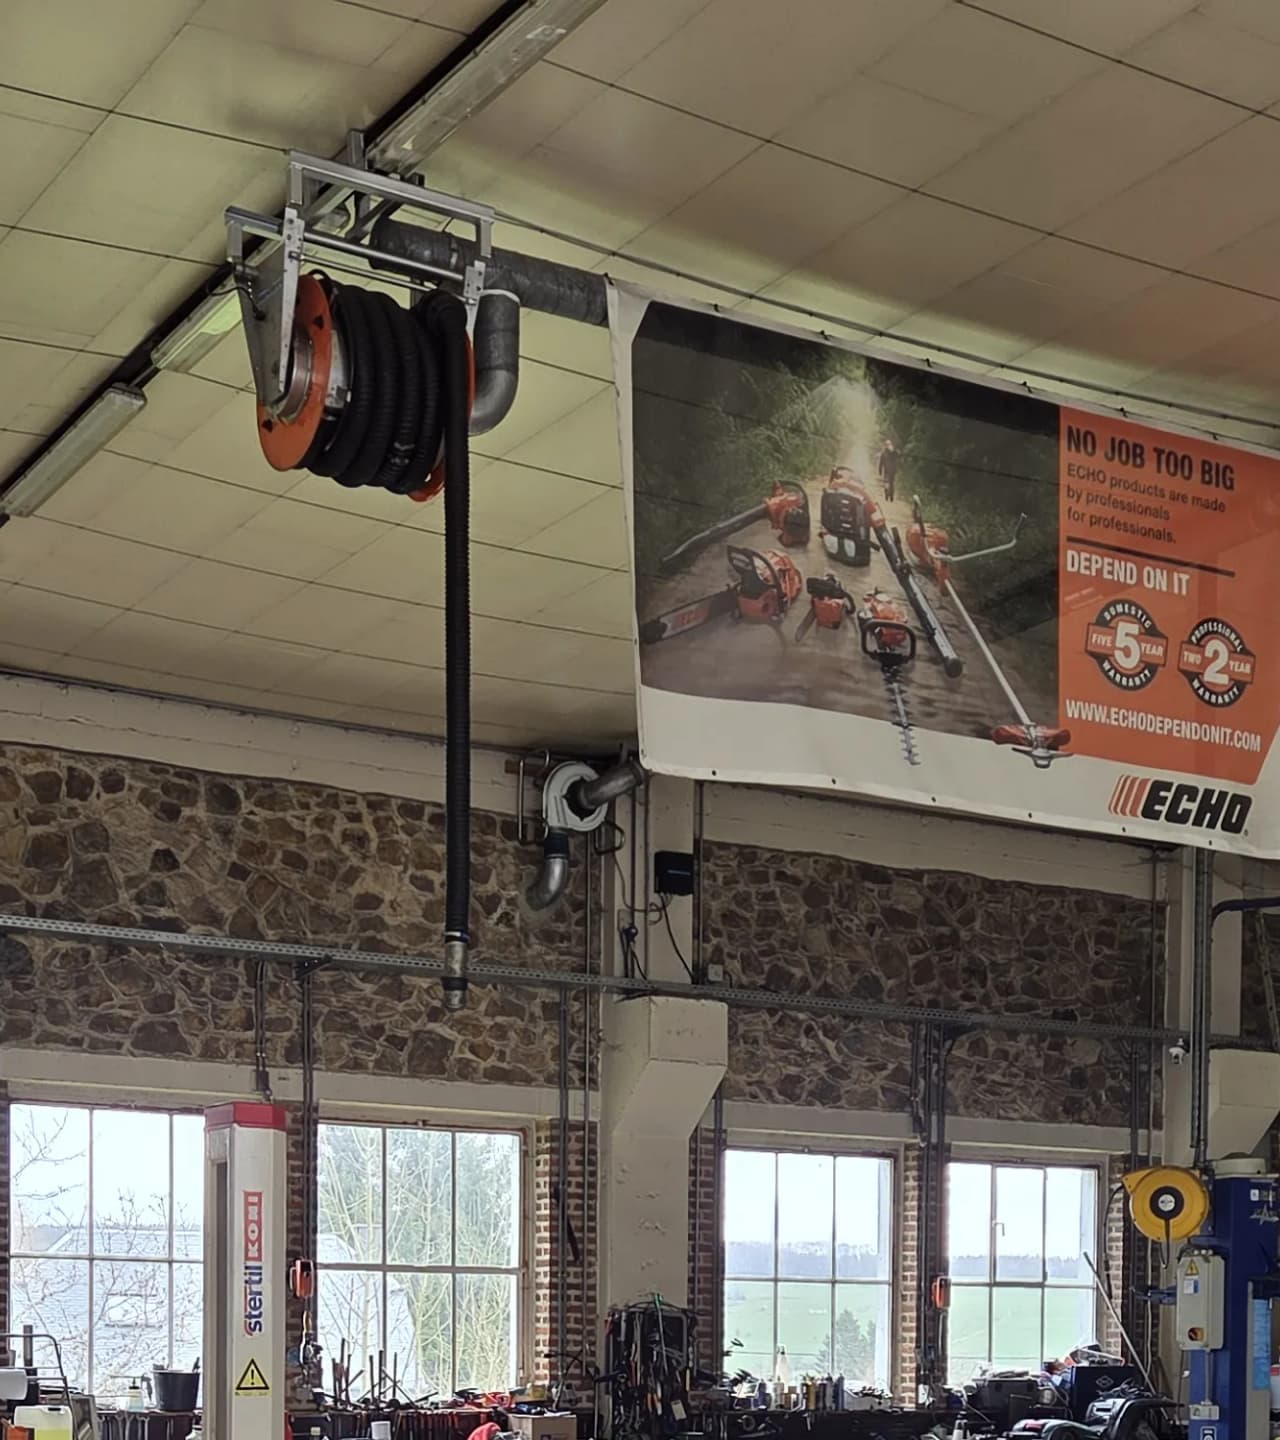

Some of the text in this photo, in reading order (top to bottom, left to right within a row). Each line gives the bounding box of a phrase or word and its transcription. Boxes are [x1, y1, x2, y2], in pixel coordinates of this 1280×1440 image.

[1067, 425, 1235, 491] NO JOB TOO BIG
[1067, 463, 1226, 513] ECHO products are made
[1067, 485, 1170, 520] by professionals
[1067, 506, 1177, 543] for professionals.
[1066, 549, 1191, 596] DEPEND ON IT
[1103, 602, 1152, 629] DOMESTIC
[1191, 621, 1243, 652] PROFESSIONAL
[1091, 620, 1164, 670] FIVE 5 YEAR
[1183, 639, 1251, 685] TWO 2 YEAR
[1102, 660, 1152, 687] WARRANTY
[1066, 699, 1261, 752] WWW.ECHODEPENDONIT.COM
[1141, 779, 1253, 835] ECHO
[244, 1265, 263, 1335] stertil
